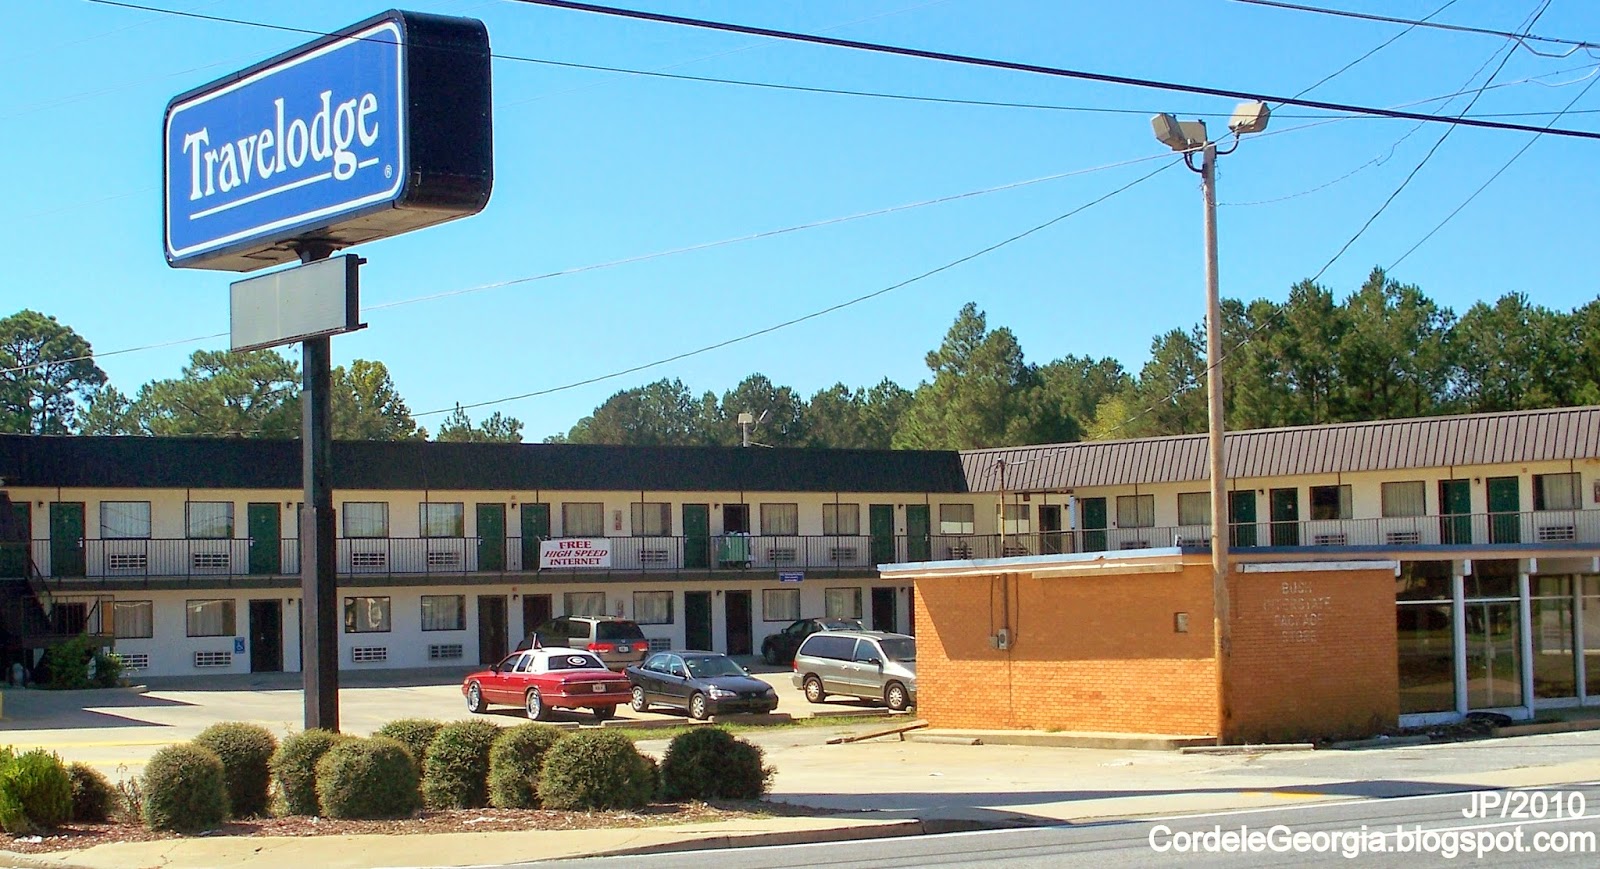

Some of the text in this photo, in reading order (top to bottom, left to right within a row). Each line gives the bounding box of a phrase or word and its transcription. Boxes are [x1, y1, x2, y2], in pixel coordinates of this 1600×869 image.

[183, 90, 379, 201] Travelodge
[559, 541, 591, 549] FREE
[544, 550, 572, 558] HIGH
